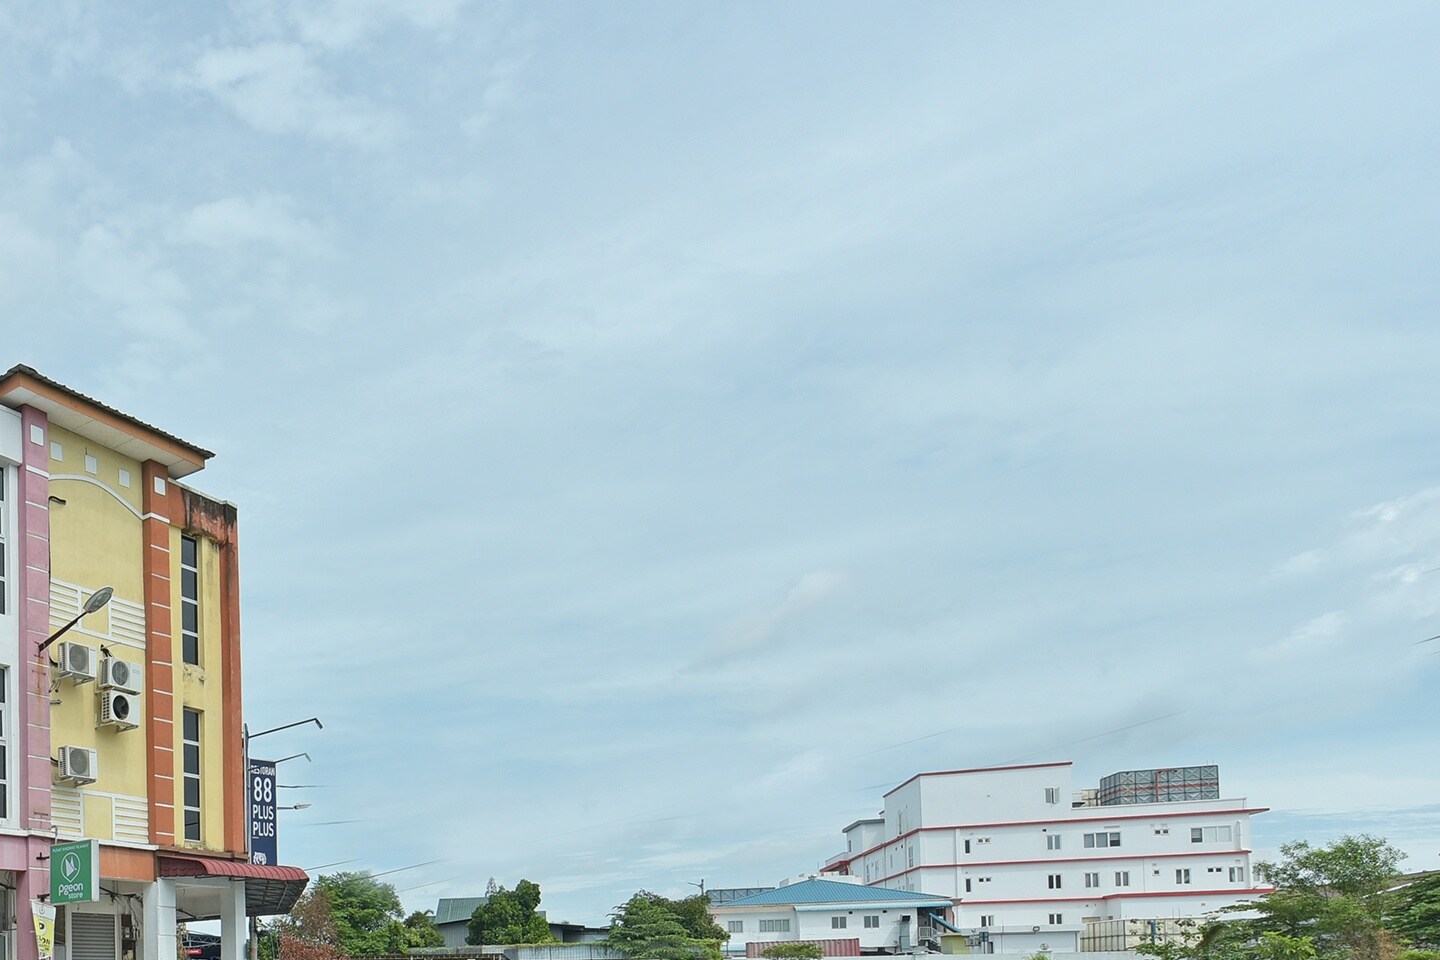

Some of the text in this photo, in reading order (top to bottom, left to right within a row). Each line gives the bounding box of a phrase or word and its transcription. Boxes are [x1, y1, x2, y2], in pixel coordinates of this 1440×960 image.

[254, 777, 272, 802] 88
[252, 804, 274, 820] PLUS
[253, 821, 274, 837] PLUS
[68, 892, 83, 900] store
